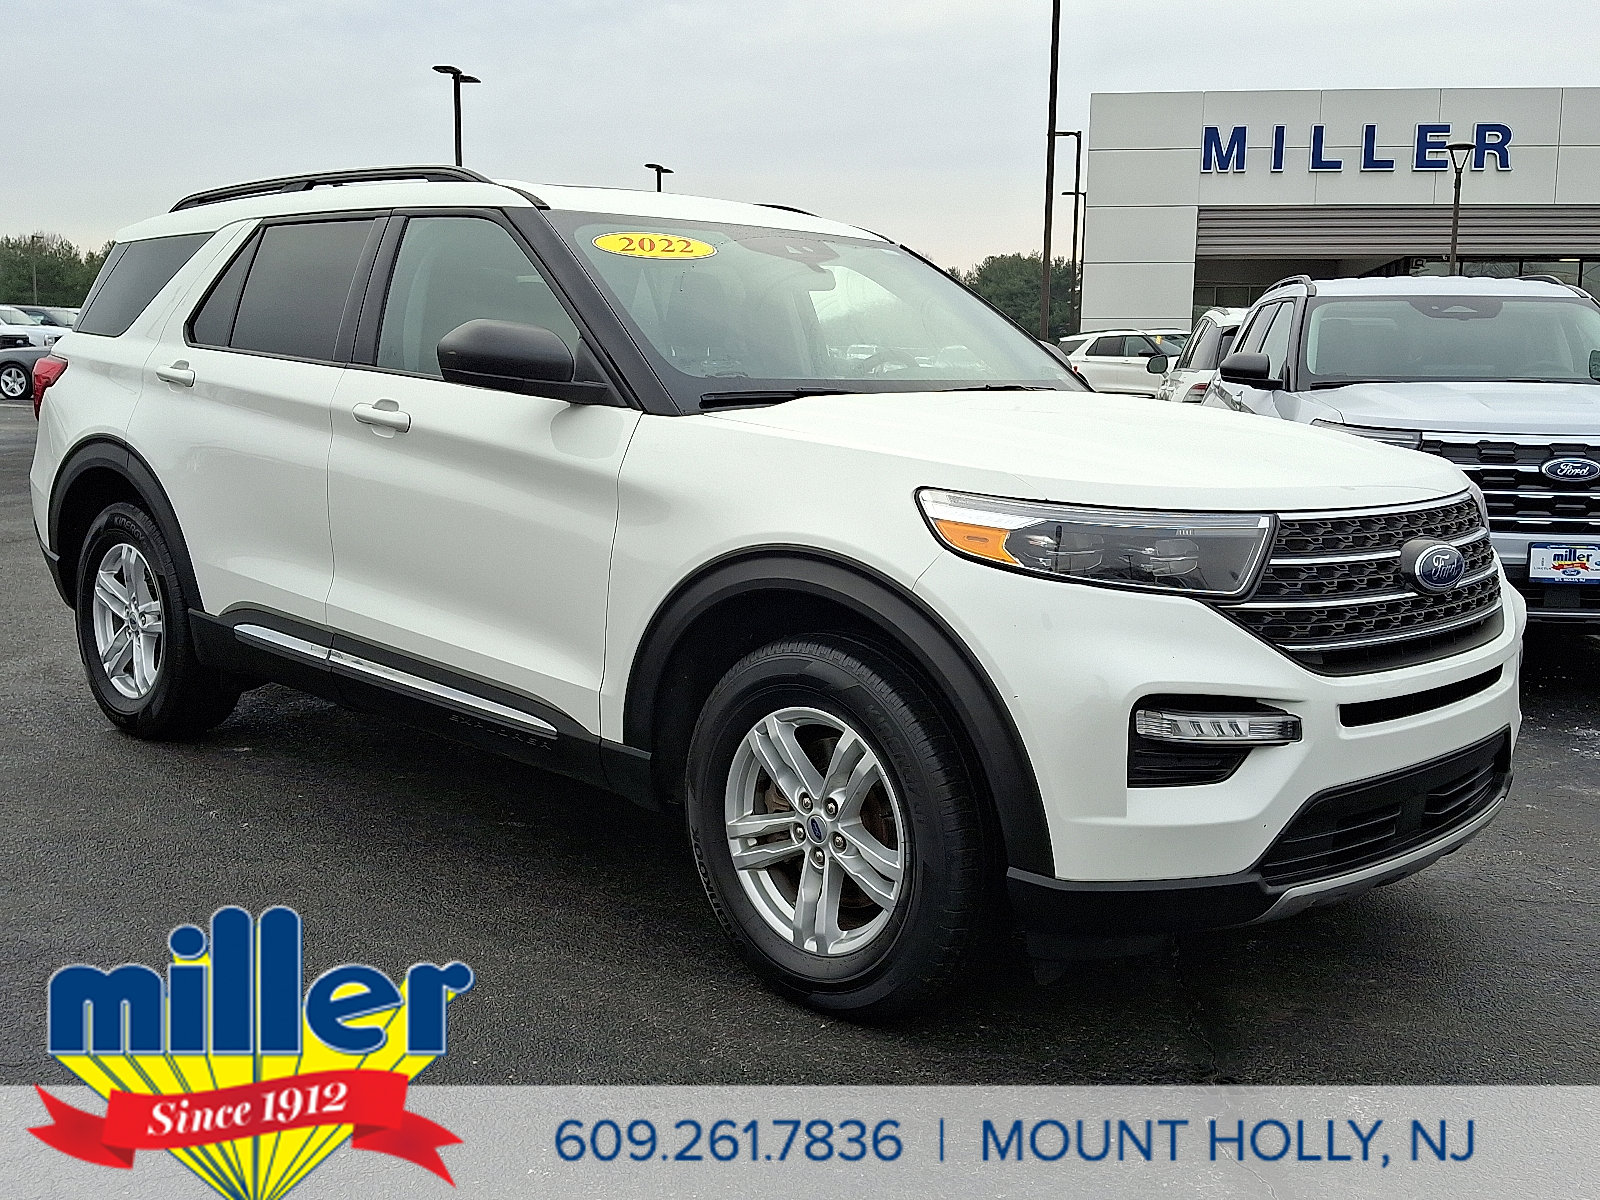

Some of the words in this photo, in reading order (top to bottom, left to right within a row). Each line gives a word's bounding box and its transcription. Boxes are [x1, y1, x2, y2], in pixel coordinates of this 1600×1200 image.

[1201, 122, 1514, 174] MILLER
[617, 236, 695, 254] 2022
[1557, 462, 1590, 476] Ford
[1553, 548, 1593, 562] miller
[1432, 554, 1457, 580] Ford
